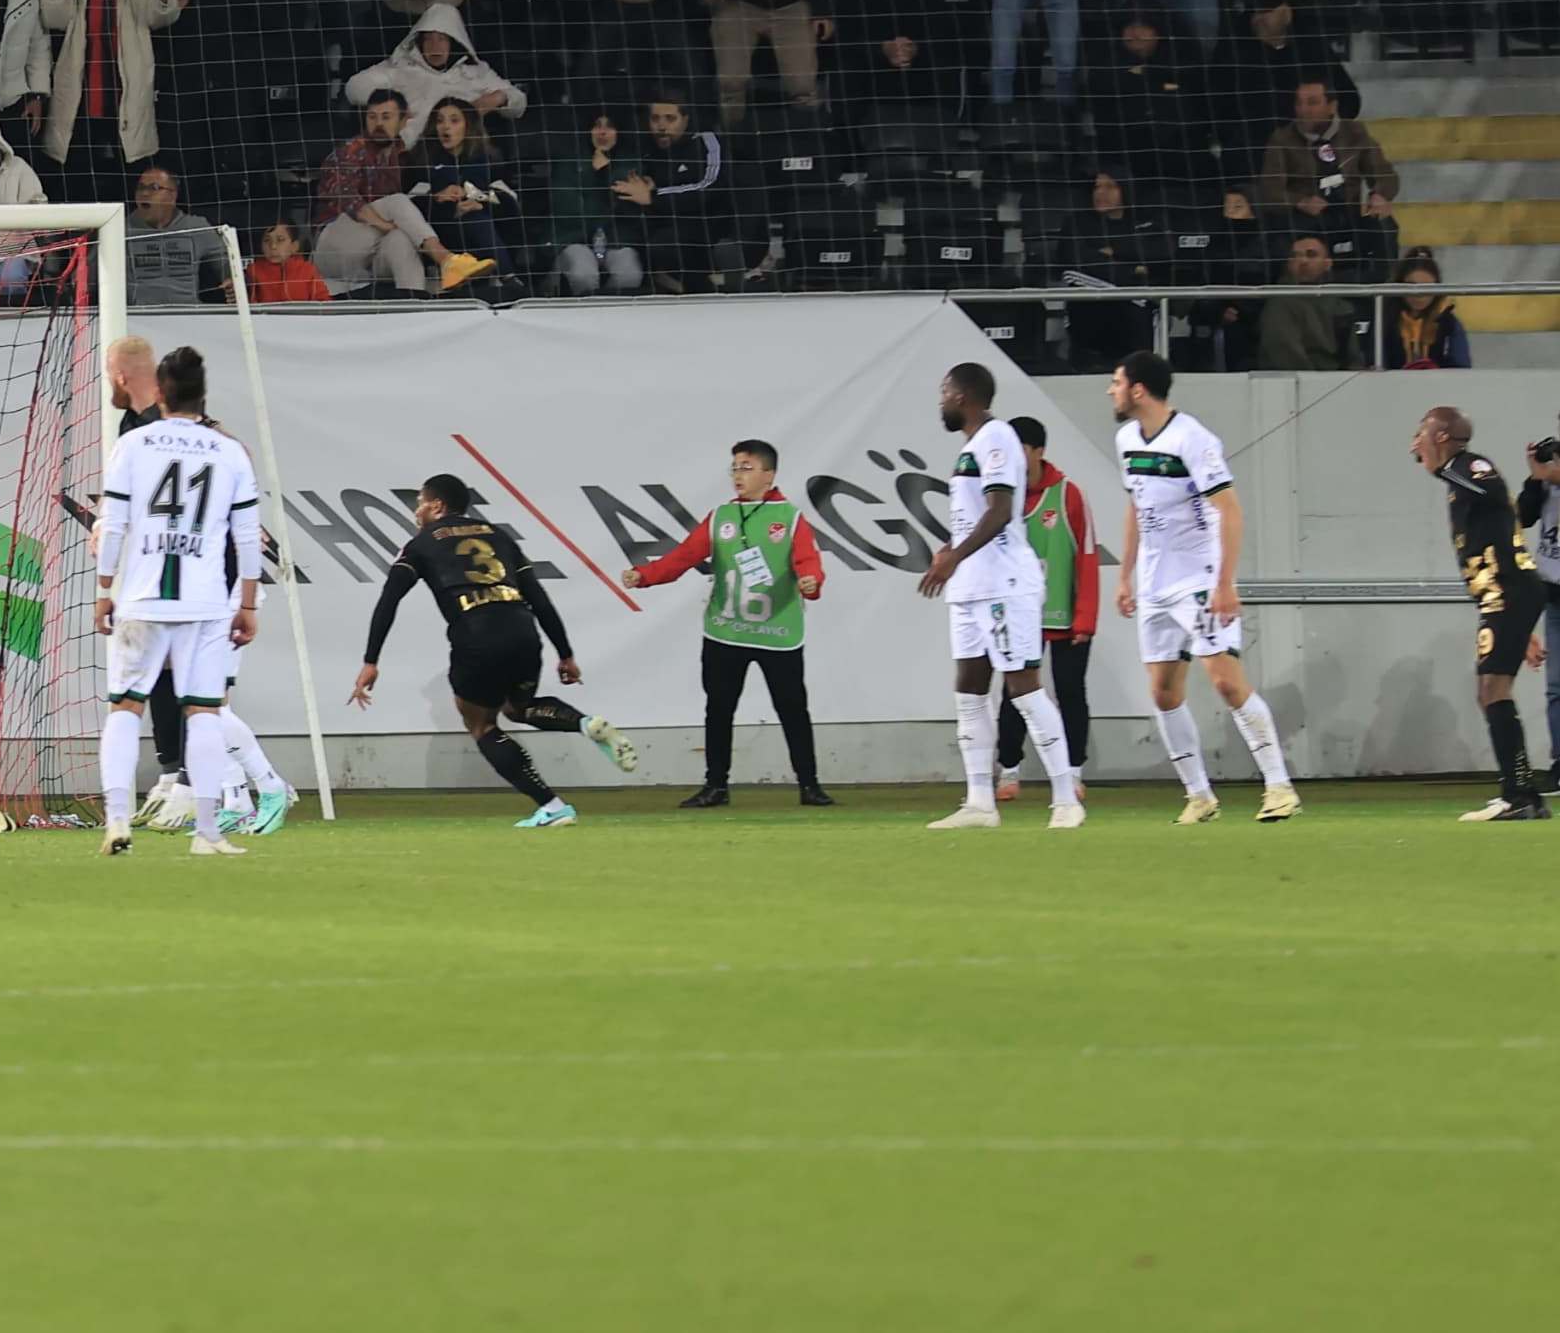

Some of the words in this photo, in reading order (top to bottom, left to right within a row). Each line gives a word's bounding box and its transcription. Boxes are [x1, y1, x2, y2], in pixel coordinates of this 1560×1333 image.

[143, 434, 222, 453] KONAK
[147, 458, 216, 534] 41
[455, 537, 507, 585] 3
[720, 569, 773, 622] 16
